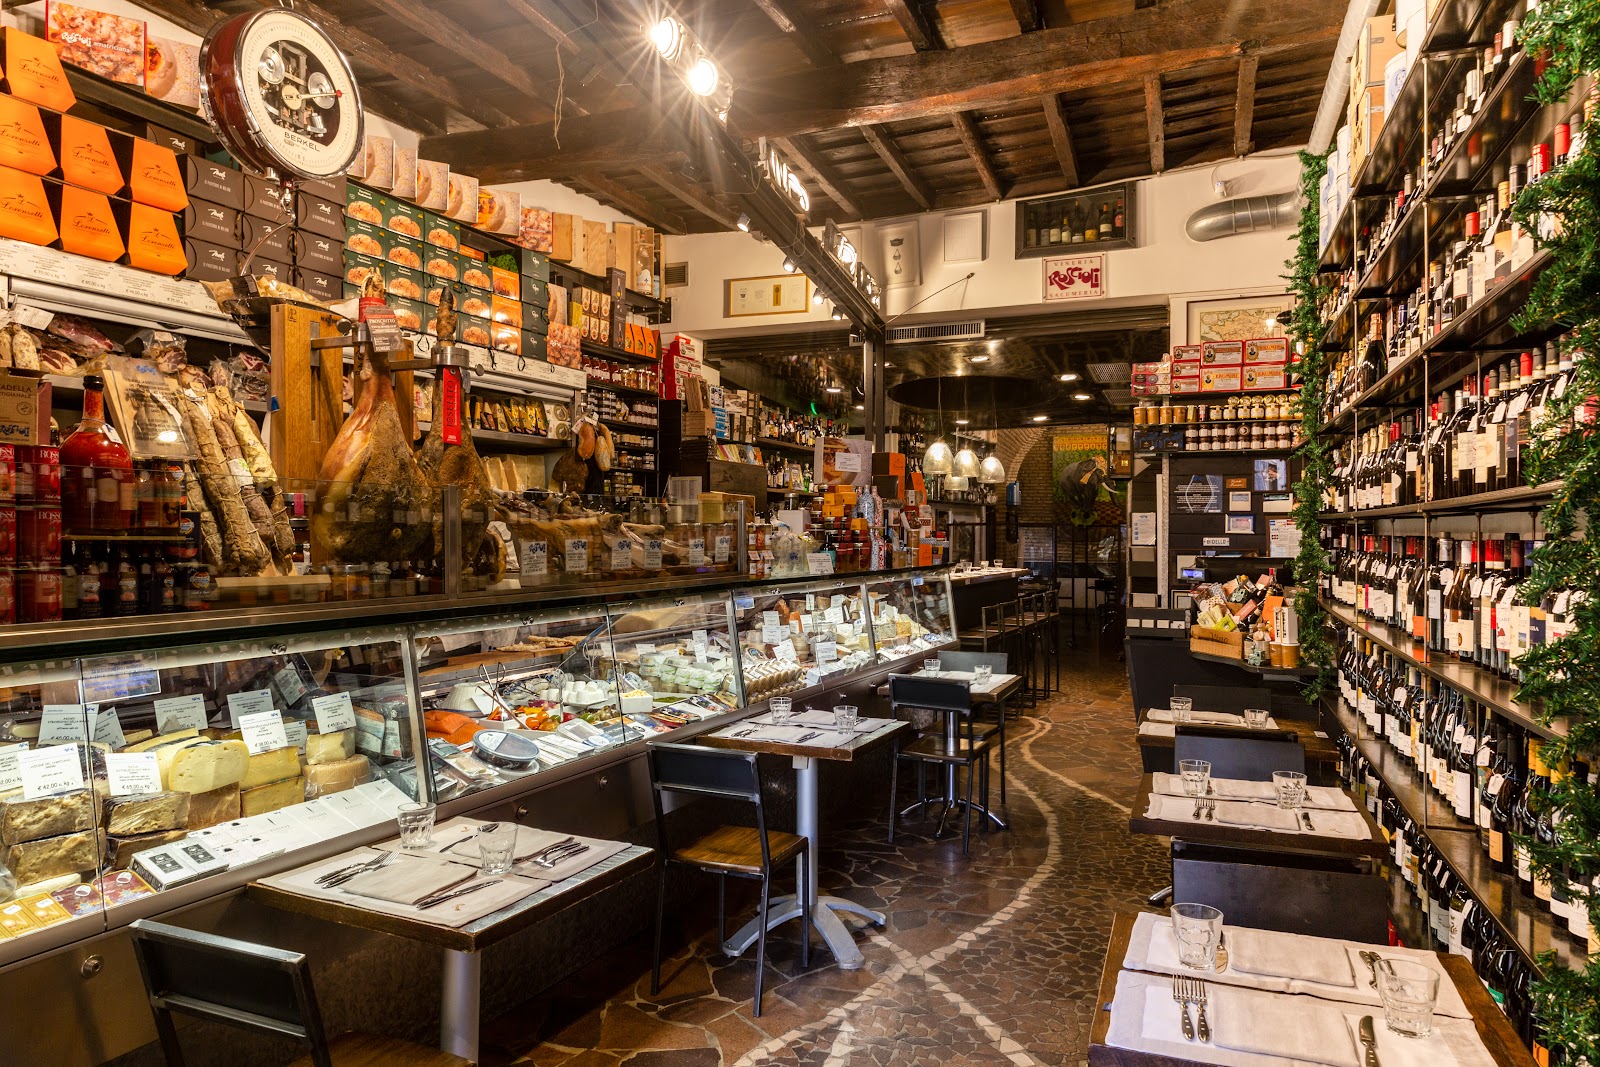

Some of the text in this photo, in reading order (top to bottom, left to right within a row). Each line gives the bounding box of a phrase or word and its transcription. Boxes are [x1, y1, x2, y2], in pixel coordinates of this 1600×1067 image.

[61, 32, 130, 53] Roscioli amatriciana
[284, 132, 320, 152] BERKEL
[446, 380, 454, 428] JOSELITO
